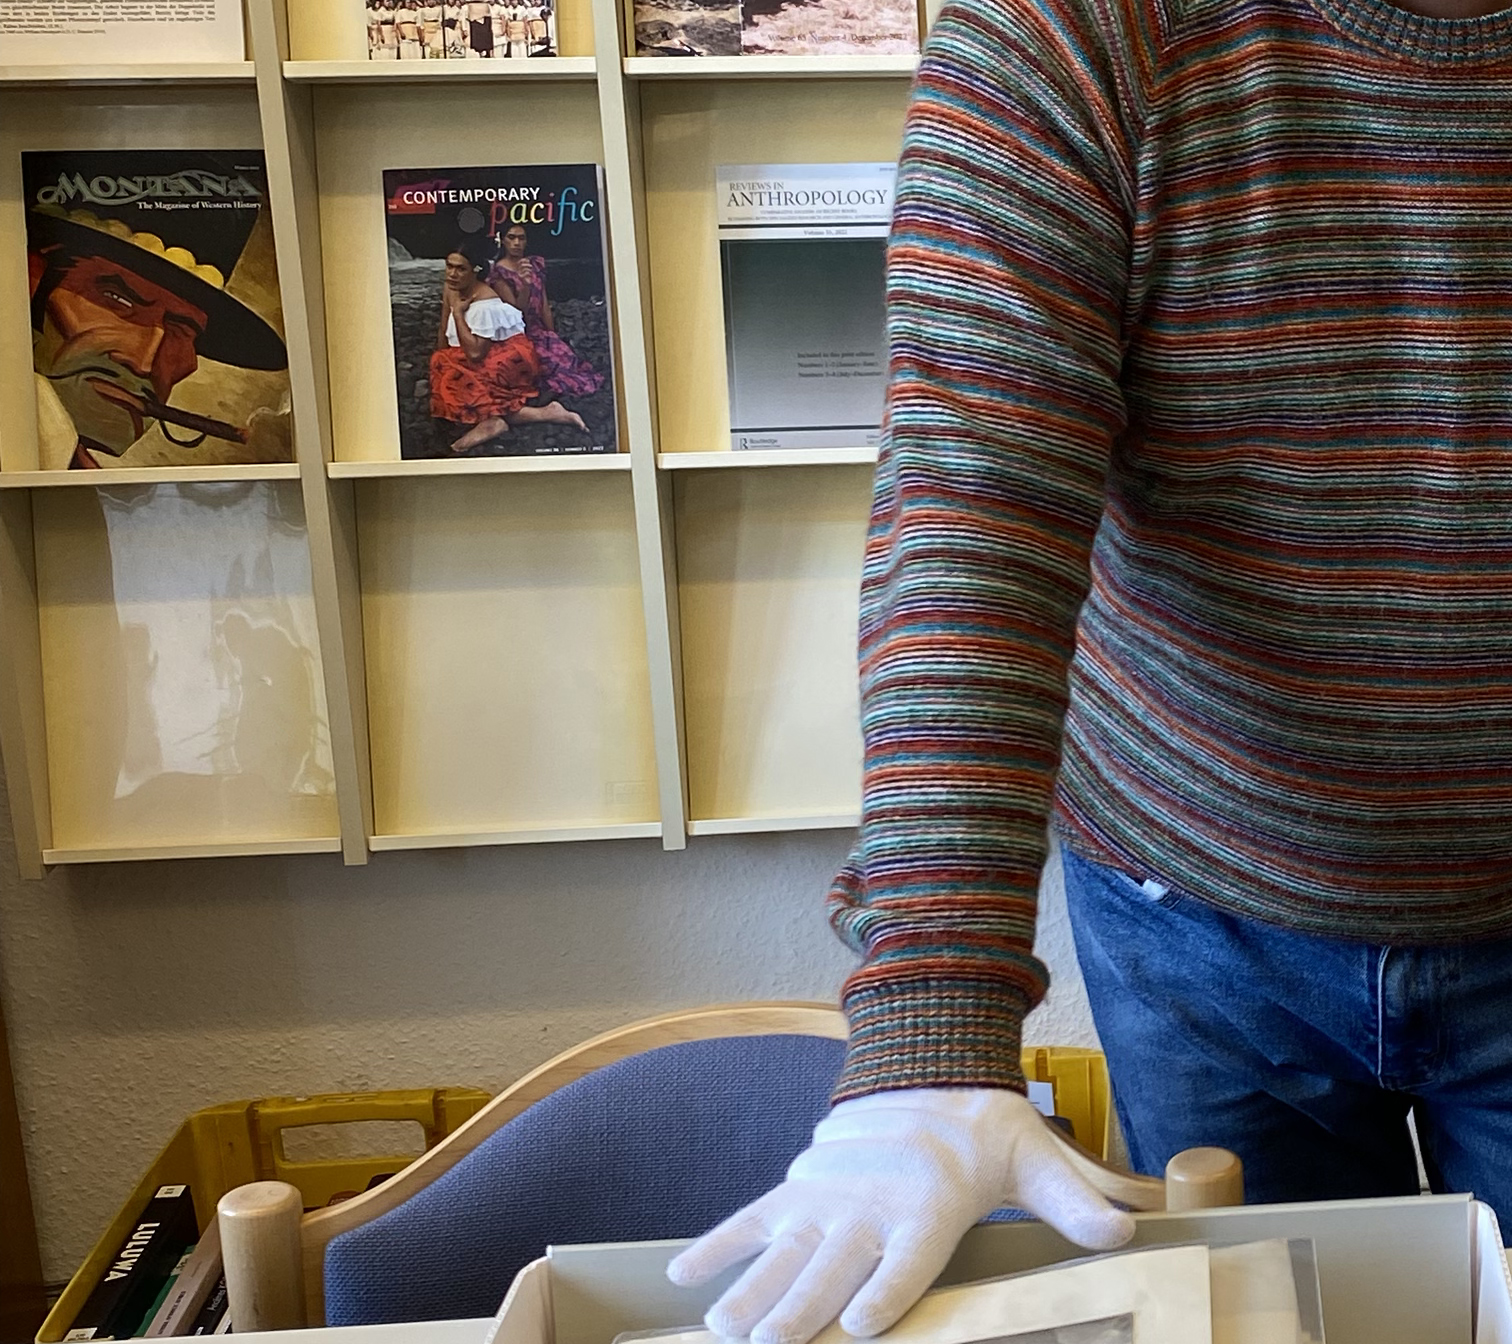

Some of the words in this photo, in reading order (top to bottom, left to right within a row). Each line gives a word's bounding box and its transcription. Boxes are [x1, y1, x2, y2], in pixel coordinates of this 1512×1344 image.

[36, 169, 262, 205] MONTANA
[403, 186, 540, 205] CONTEMPORARY
[729, 182, 771, 191] REVIEWS
[774, 182, 784, 190] IN
[137, 201, 153, 210] The
[154, 201, 189, 211] Magazine
[191, 201, 200, 209] of
[201, 201, 233, 209] Western
[234, 201, 262, 210] History
[727, 190, 888, 206] ANTHROPOLOGY
[487, 186, 594, 238] pacific
[104, 1222, 160, 1282] LULUWA
